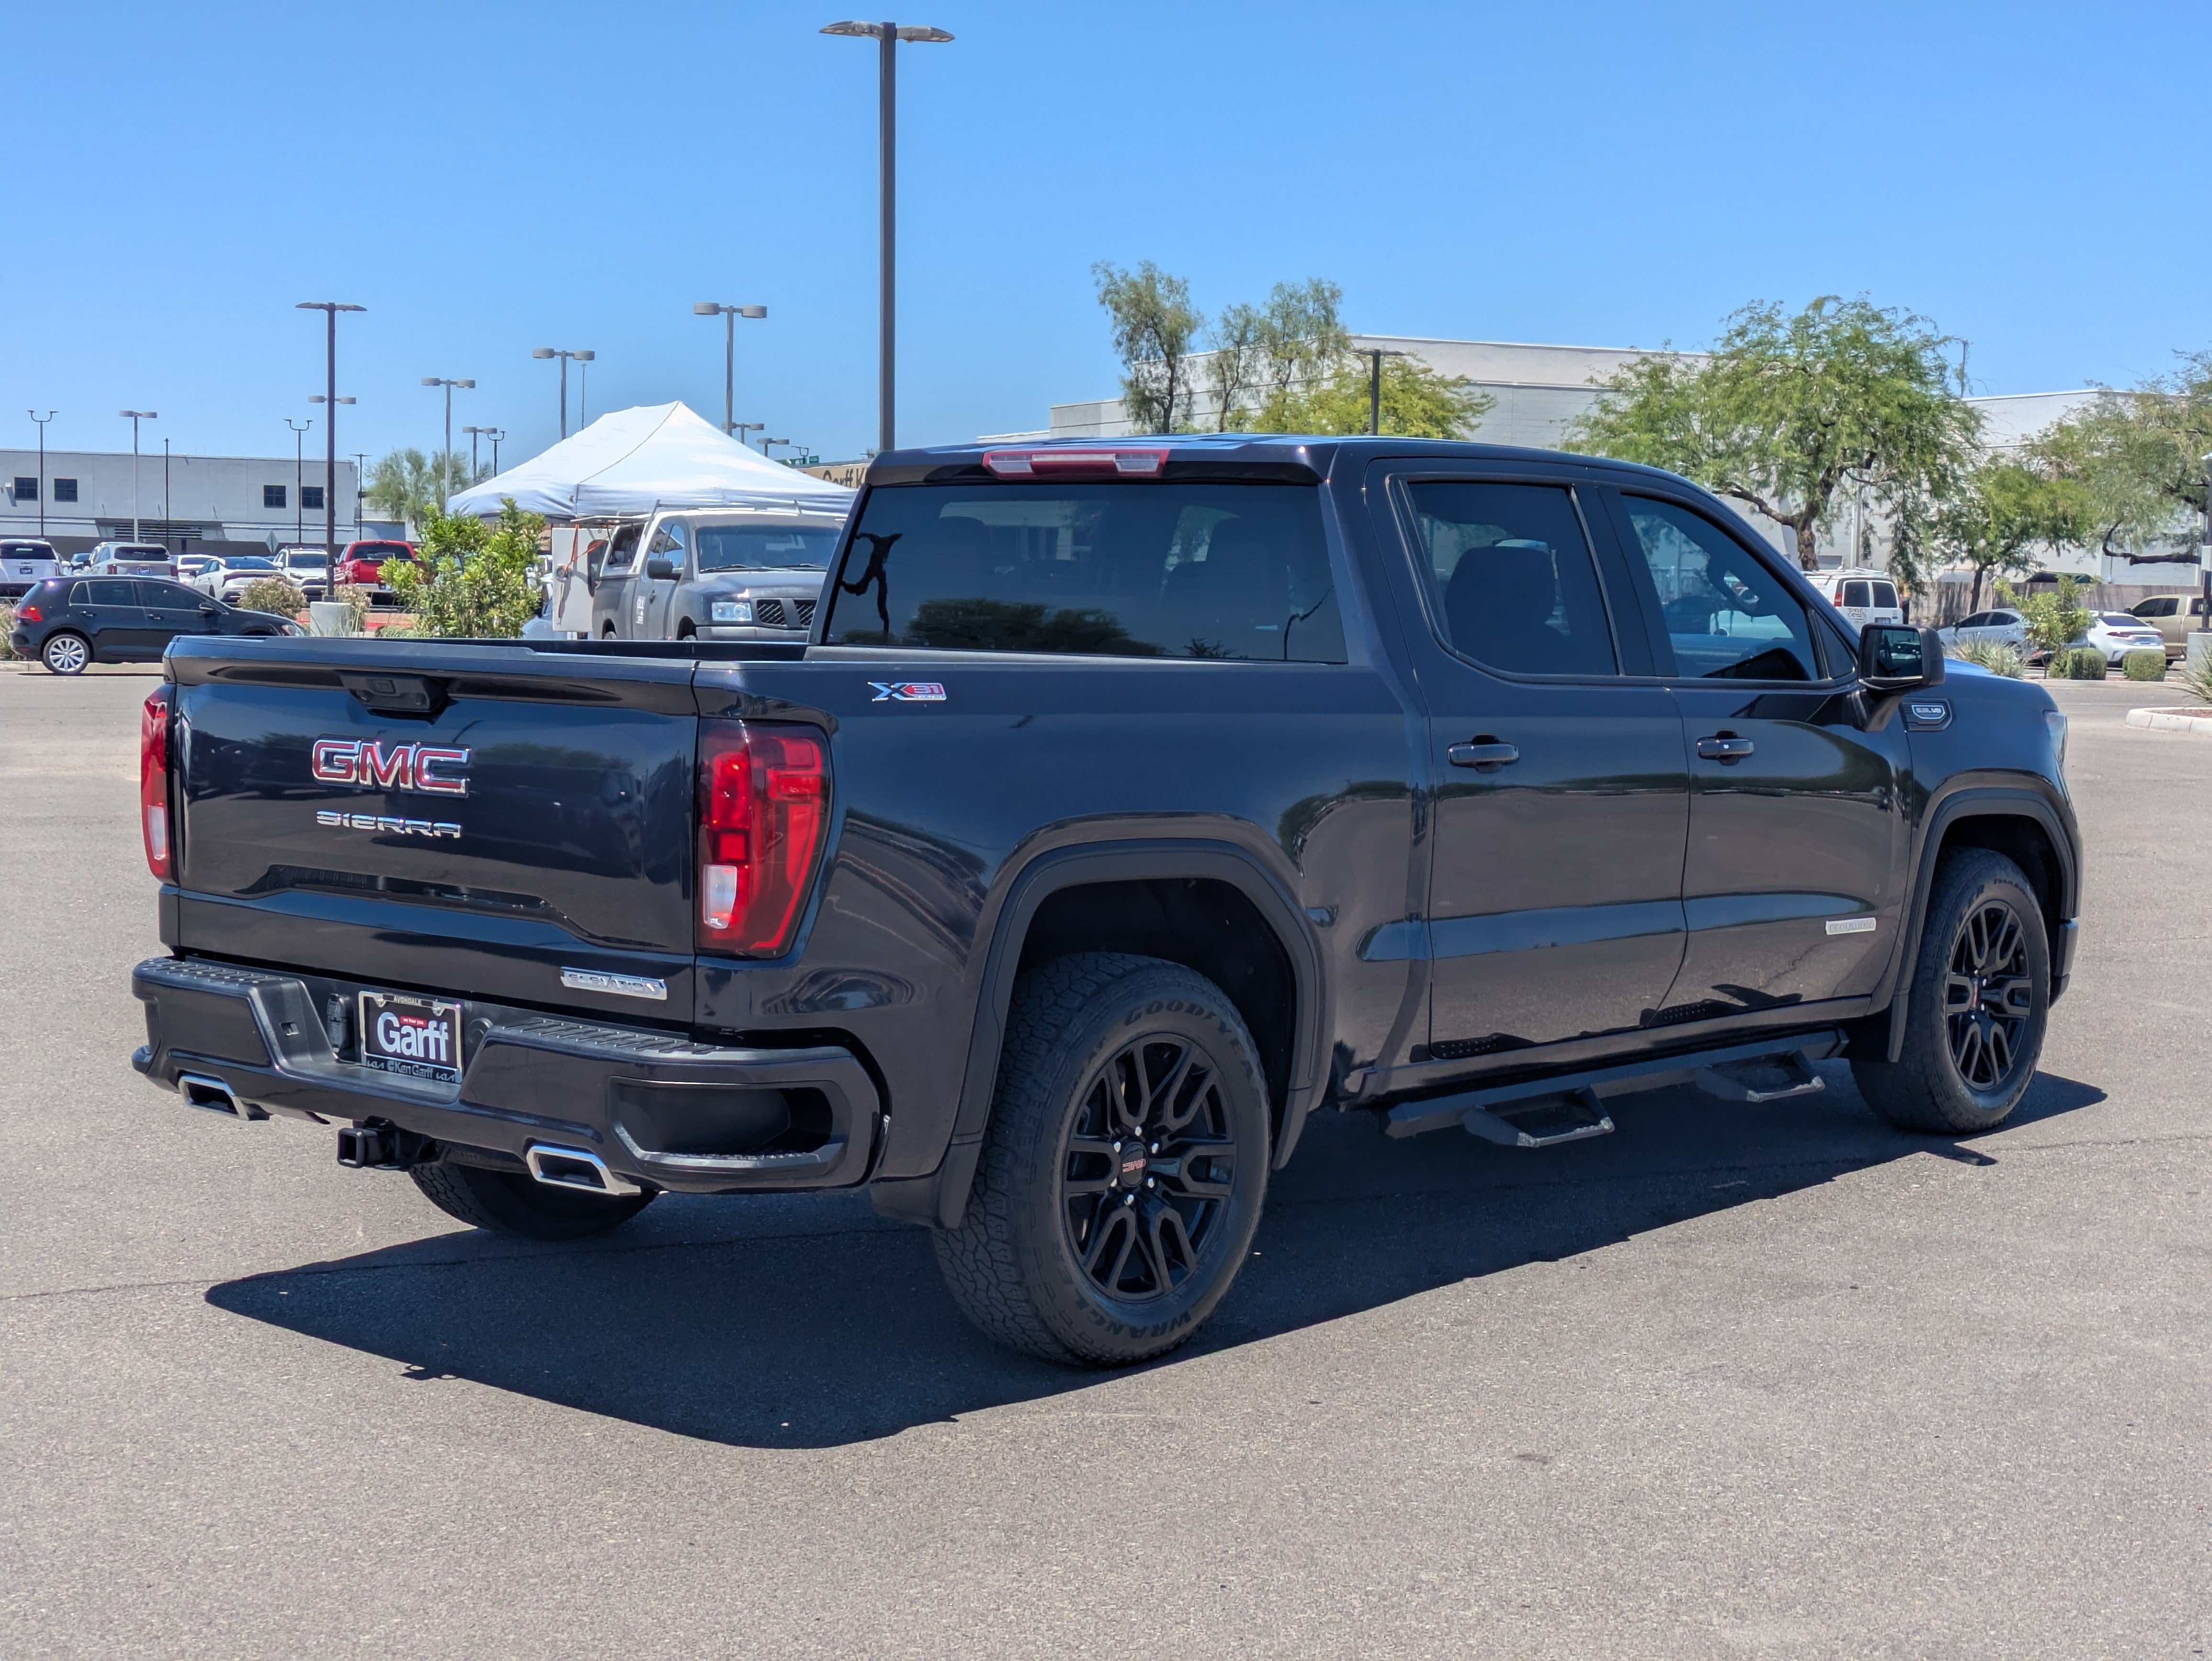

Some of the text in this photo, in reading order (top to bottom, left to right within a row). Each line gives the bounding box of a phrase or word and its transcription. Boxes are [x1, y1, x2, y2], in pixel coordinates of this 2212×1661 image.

[312, 736, 472, 797] GMC
[316, 810, 462, 839] SIERRA
[568, 973, 661, 997] ELEVATION
[393, 996, 422, 1006] AVONDALE
[377, 1011, 449, 1062] Garff
[1124, 1000, 1262, 1109] GOODYEAR
[395, 1061, 411, 1074] Ken
[412, 1064, 433, 1079] Garff
